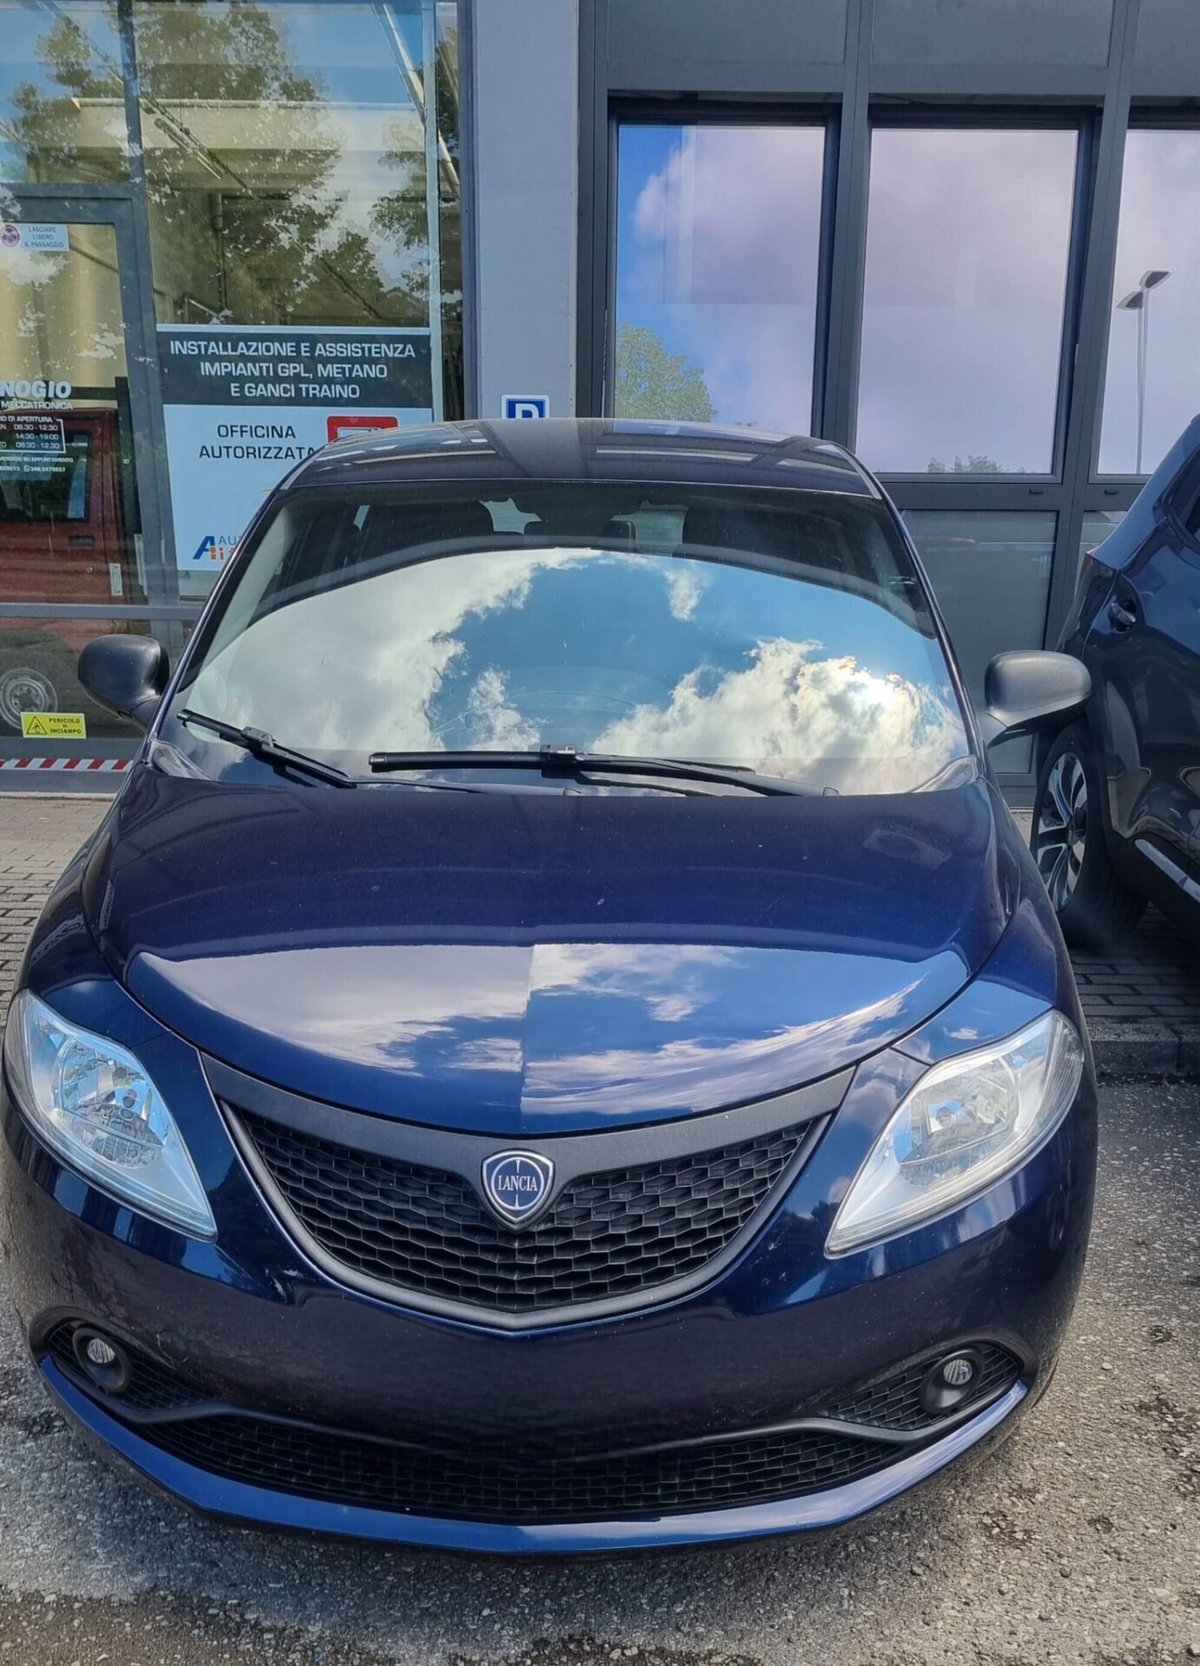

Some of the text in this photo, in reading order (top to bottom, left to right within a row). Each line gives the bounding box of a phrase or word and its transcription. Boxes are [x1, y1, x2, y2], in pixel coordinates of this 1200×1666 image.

[170, 340, 416, 358] INSTALLAZIONE E ASSISTENZA
[200, 362, 388, 379] IMPIANTI GPL, METANO
[230, 383, 360, 399] E GANCI TRAINO
[1, 400, 74, 410] MECCATRONICA
[217, 424, 296, 439] OFFICINA
[199, 445, 317, 460] AUTORIZZATA
[497, 1175, 538, 1192] LANCIA
